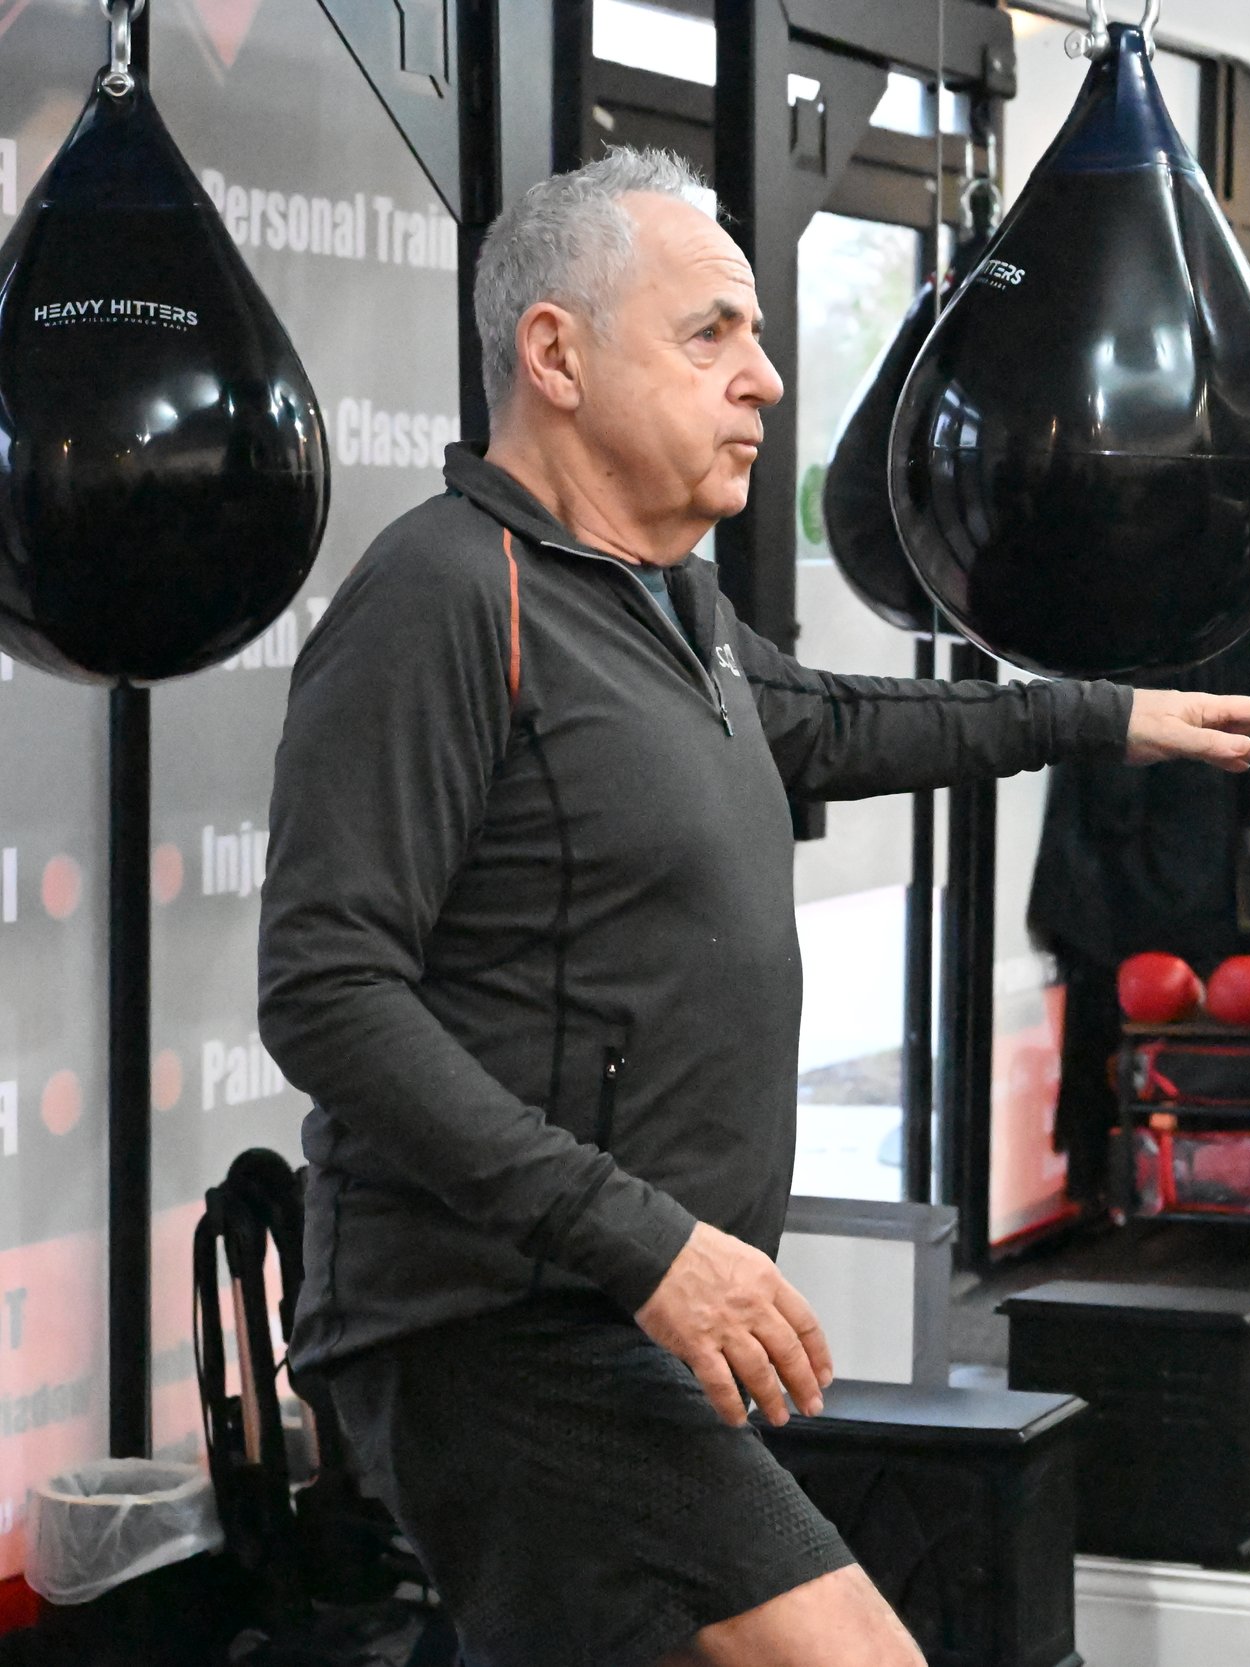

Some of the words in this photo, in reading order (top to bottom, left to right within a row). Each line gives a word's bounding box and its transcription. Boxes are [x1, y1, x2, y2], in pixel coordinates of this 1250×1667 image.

[202, 168, 366, 260] Personal
[34, 299, 104, 321] HEAVY
[110, 299, 198, 326] HITTERS
